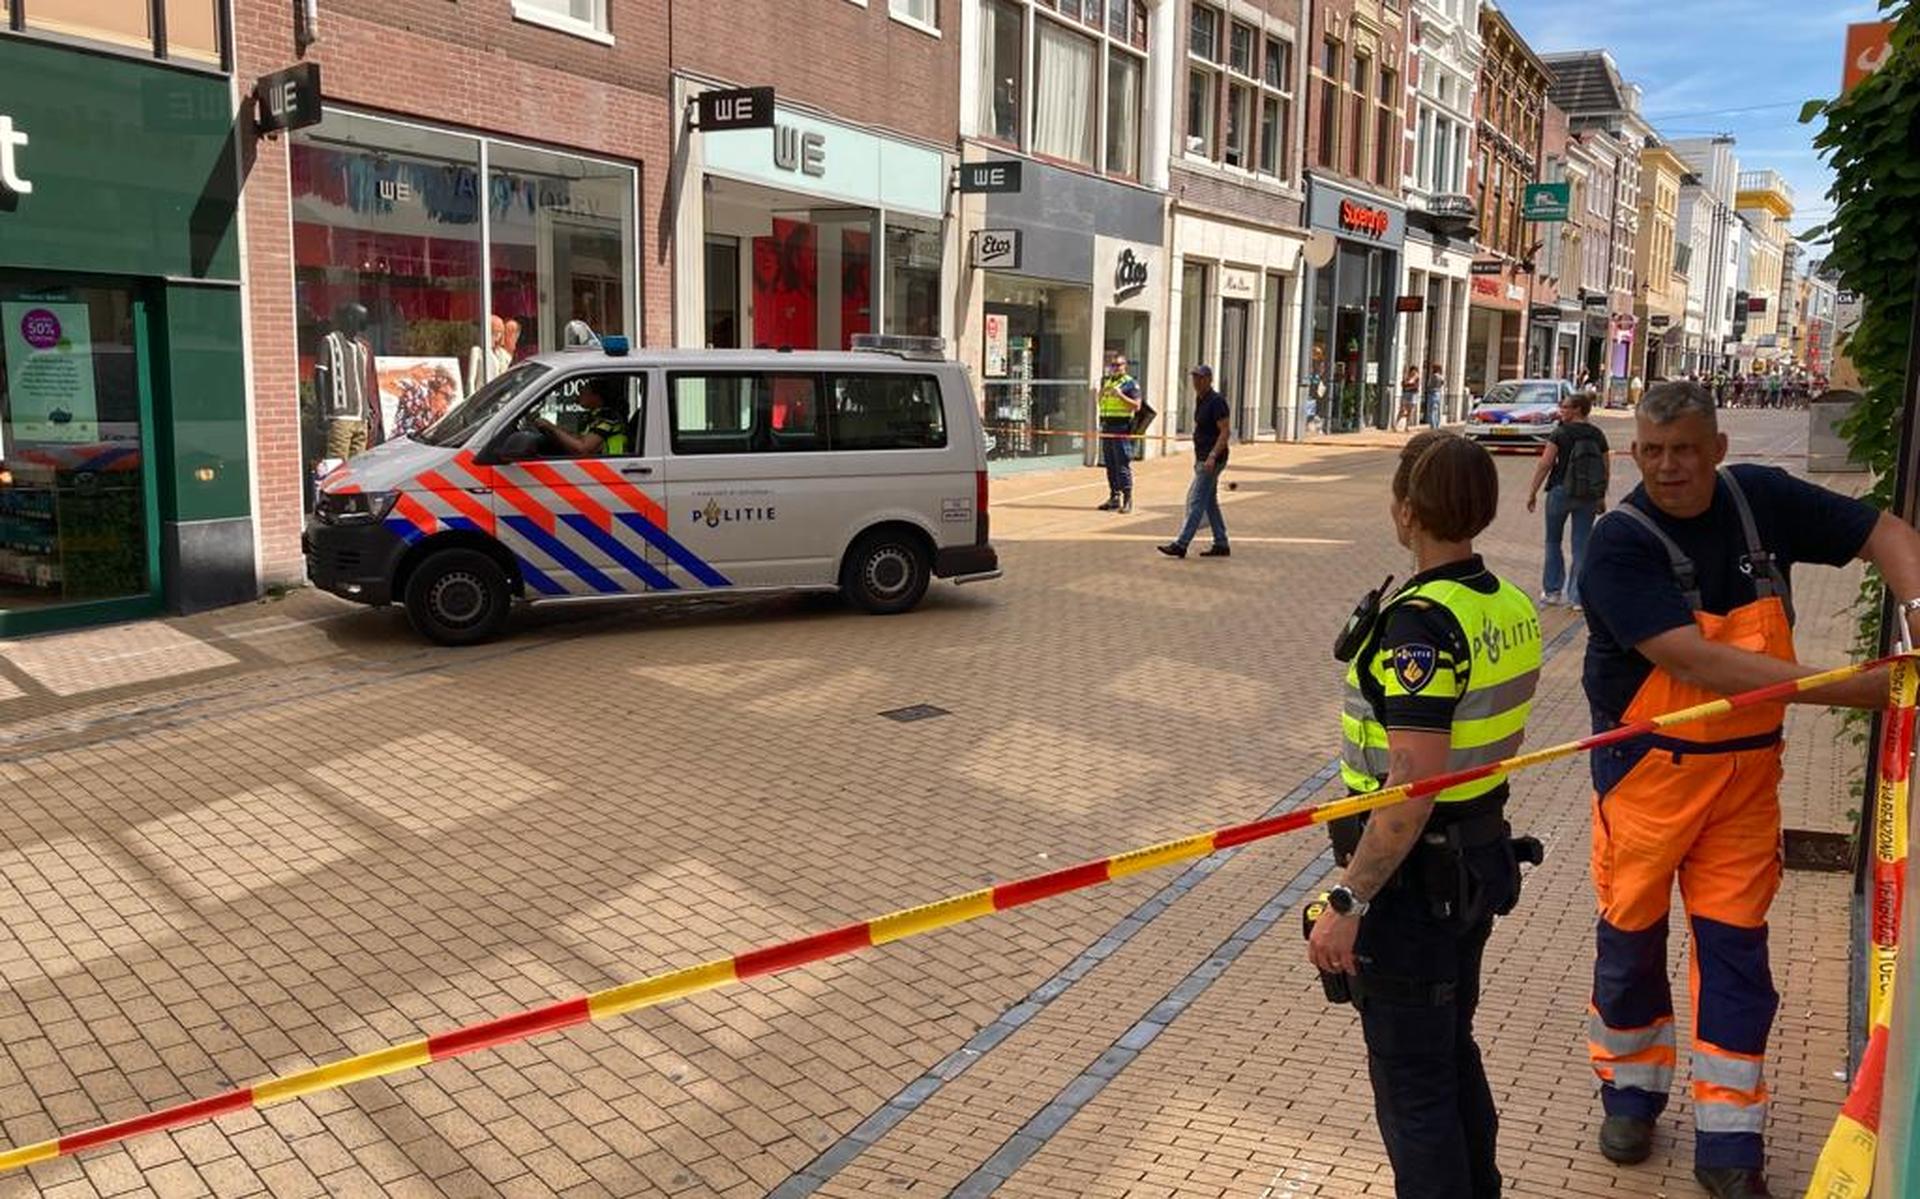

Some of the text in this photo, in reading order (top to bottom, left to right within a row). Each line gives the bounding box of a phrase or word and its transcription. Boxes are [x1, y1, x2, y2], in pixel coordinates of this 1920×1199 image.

[269, 81, 297, 116] WE
[715, 96, 753, 121] WE
[772, 123, 827, 179] WE
[974, 168, 1006, 186] WE
[379, 179, 411, 202] WE
[981, 235, 1012, 258] Etos
[1117, 247, 1149, 291] Etos
[27, 323, 55, 336] 50%
[692, 502, 776, 528] POLITIE
[1472, 614, 1541, 664] POLITIE
[1396, 648, 1431, 660] POLITIE
